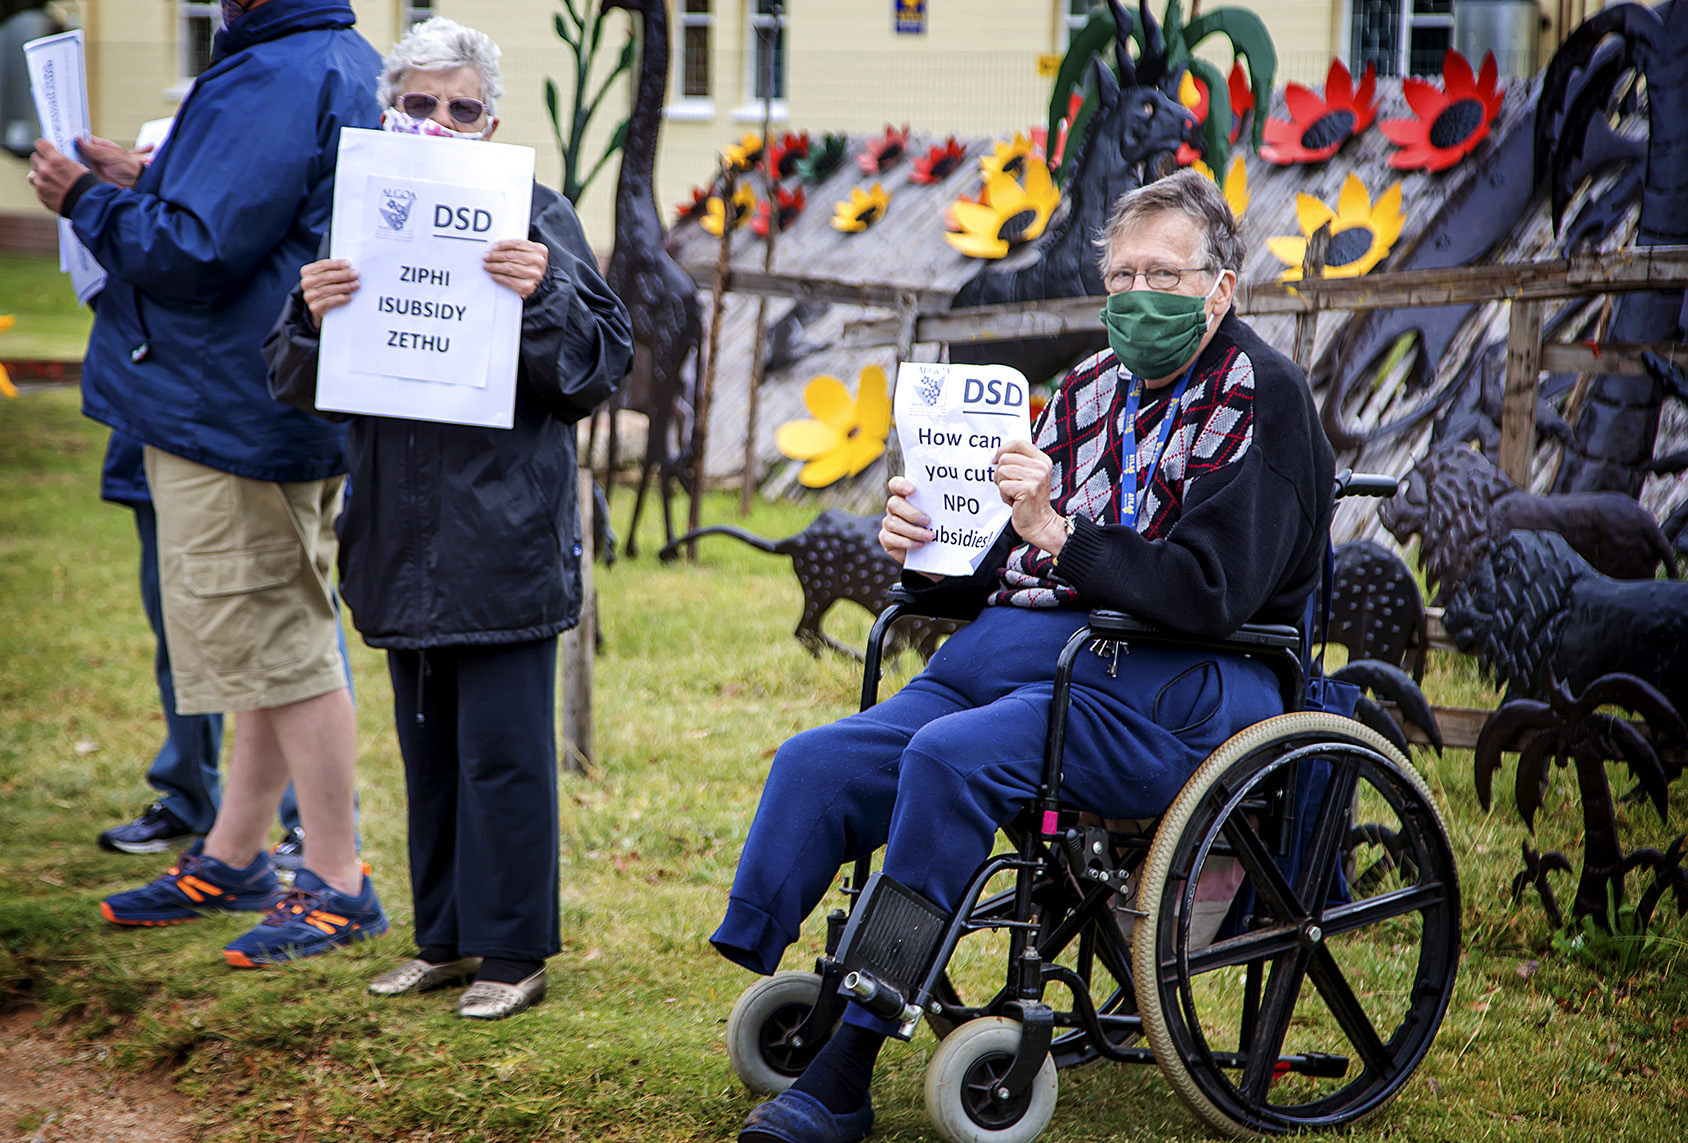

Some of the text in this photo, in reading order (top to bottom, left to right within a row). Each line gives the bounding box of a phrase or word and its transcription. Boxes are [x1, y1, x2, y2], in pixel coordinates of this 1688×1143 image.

[381, 188, 417, 201] ALGOA
[433, 204, 492, 232] DSD
[399, 265, 450, 287] ZIPHI
[378, 295, 467, 322] ISUBSIDY
[387, 330, 450, 353] ZETHU
[963, 378, 1023, 407] DSD
[918, 428, 1001, 449] How can
[925, 464, 995, 482] you cut
[943, 494, 979, 515] NPO
[923, 525, 994, 548] ubsidies!
